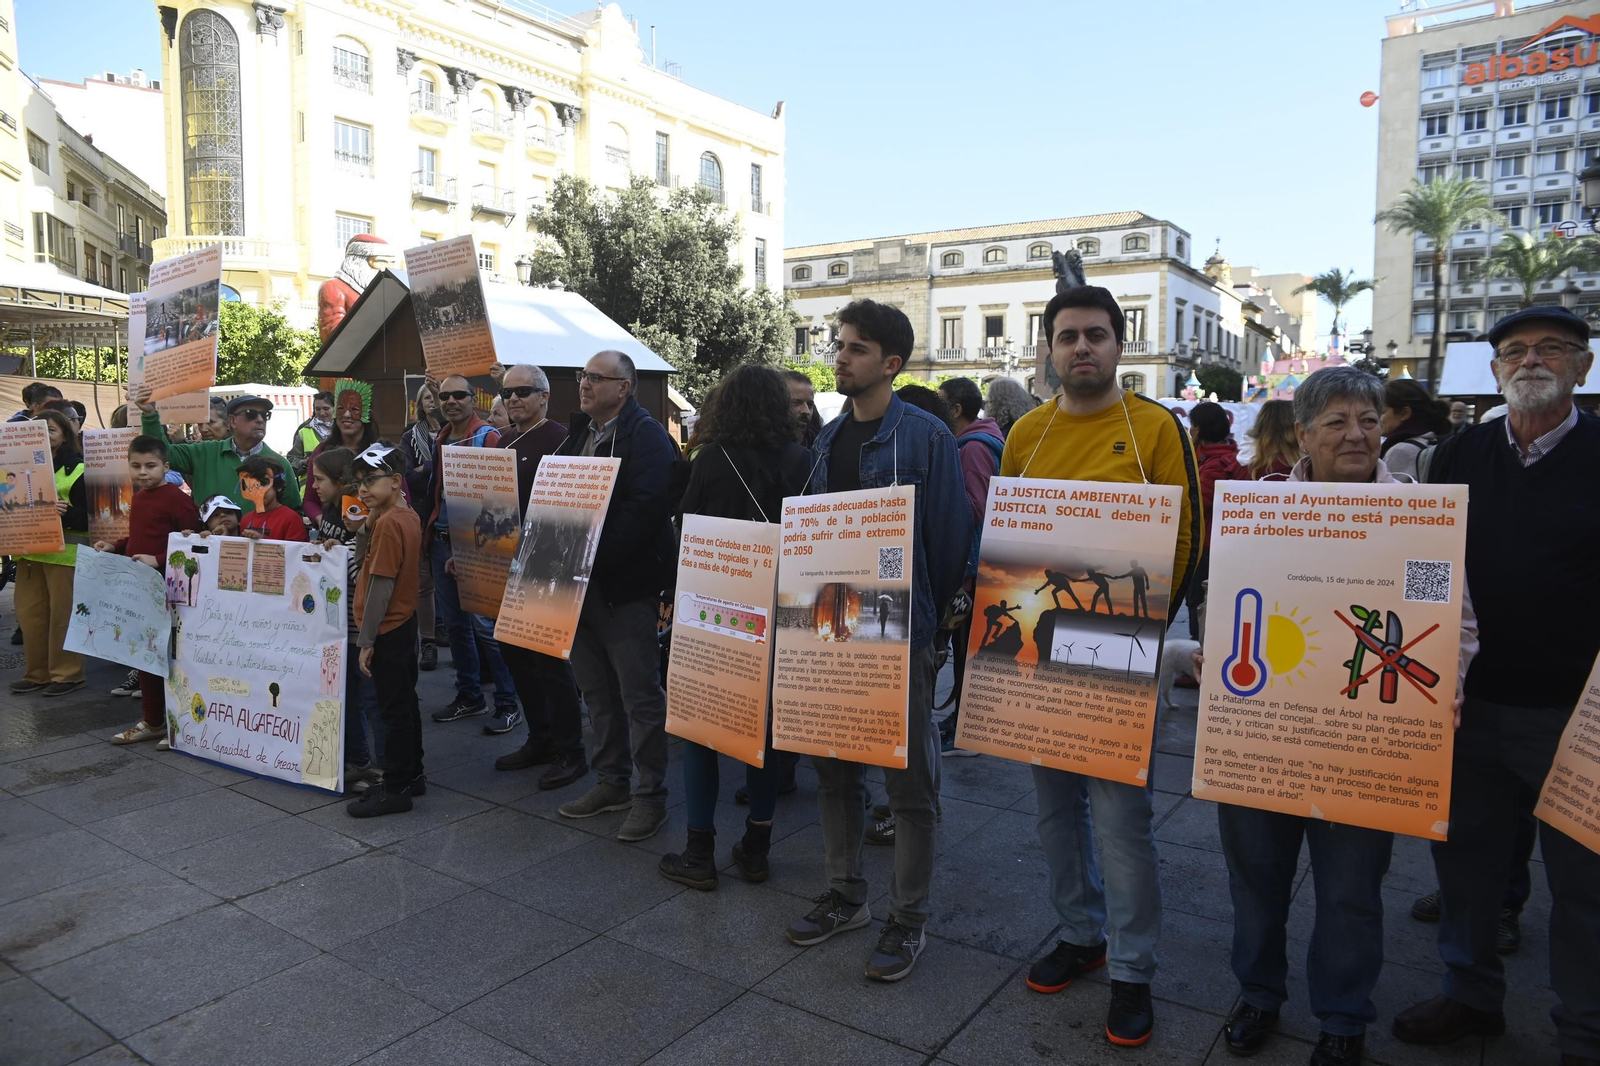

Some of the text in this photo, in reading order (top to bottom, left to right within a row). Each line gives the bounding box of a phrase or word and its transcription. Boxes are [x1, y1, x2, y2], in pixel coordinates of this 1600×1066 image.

[1500, 72, 1577, 91] inmobiliarias
[784, 505, 795, 516] Sin
[797, 502, 830, 514] medidas
[832, 498, 878, 511] adecuadas
[994, 485, 1171, 508] La JUSTICIA AMBIENTAL y la
[1222, 492, 1455, 510] Replican al Ayuntamiento que la
[784, 510, 906, 529] un 70% de la población
[992, 501, 1171, 524] JUSTICIA SOCIAL deben ir
[1221, 507, 1454, 526] poda en verde no está pensada
[990, 516, 1053, 531] de la mano
[1220, 523, 1366, 539] para árboles urbanos
[683, 533, 689, 542] El
[689, 534, 705, 545] clima
[714, 538, 741, 550] Córdoba
[752, 543, 773, 554] 2100:
[783, 527, 905, 544] podría sufrir clima extremo
[681, 545, 772, 568] 79 noches tropicales y 61
[793, 545, 812, 555] 2050
[680, 557, 692, 567] días
[698, 560, 711, 570] más
[711, 562, 720, 572] de
[720, 564, 729, 574] 40
[730, 567, 752, 578] grados
[1286, 573, 1323, 583] Cordópolis,
[1346, 577, 1364, 585] junio
[1376, 578, 1394, 586] 2024
[208, 702, 234, 725] AFA
[1208, 703, 1261, 717] declaraciones
[1263, 710, 1277, 719] del
[1324, 718, 1349, 728] sobre
[1365, 723, 1384, 733] plan
[1387, 726, 1400, 735] de
[1402, 729, 1426, 738] poda
[1209, 692, 1218, 701] La
[1222, 693, 1265, 707] Plataforma
[1283, 701, 1317, 713] Defensa
[1321, 706, 1335, 715] del
[1338, 706, 1362, 719] Árbol
[1366, 711, 1378, 721] ha
[1382, 715, 1424, 726] replicado
[1429, 719, 1443, 728] las
[964, 711, 984, 721] Nunca
[986, 716, 1015, 727] podemos
[1017, 722, 1040, 732] olvidar
[1042, 726, 1049, 734] la
[1051, 729, 1088, 741] solidaridad
[1098, 738, 1120, 748] apoyo
[1131, 742, 1142, 751] los
[212, 732, 251, 760] Capacidad
[256, 746, 268, 764] de
[1557, 763, 1594, 787] Luchar contra
[1552, 775, 1590, 800] graves efectos
[1548, 786, 1594, 816] enfermedades de
